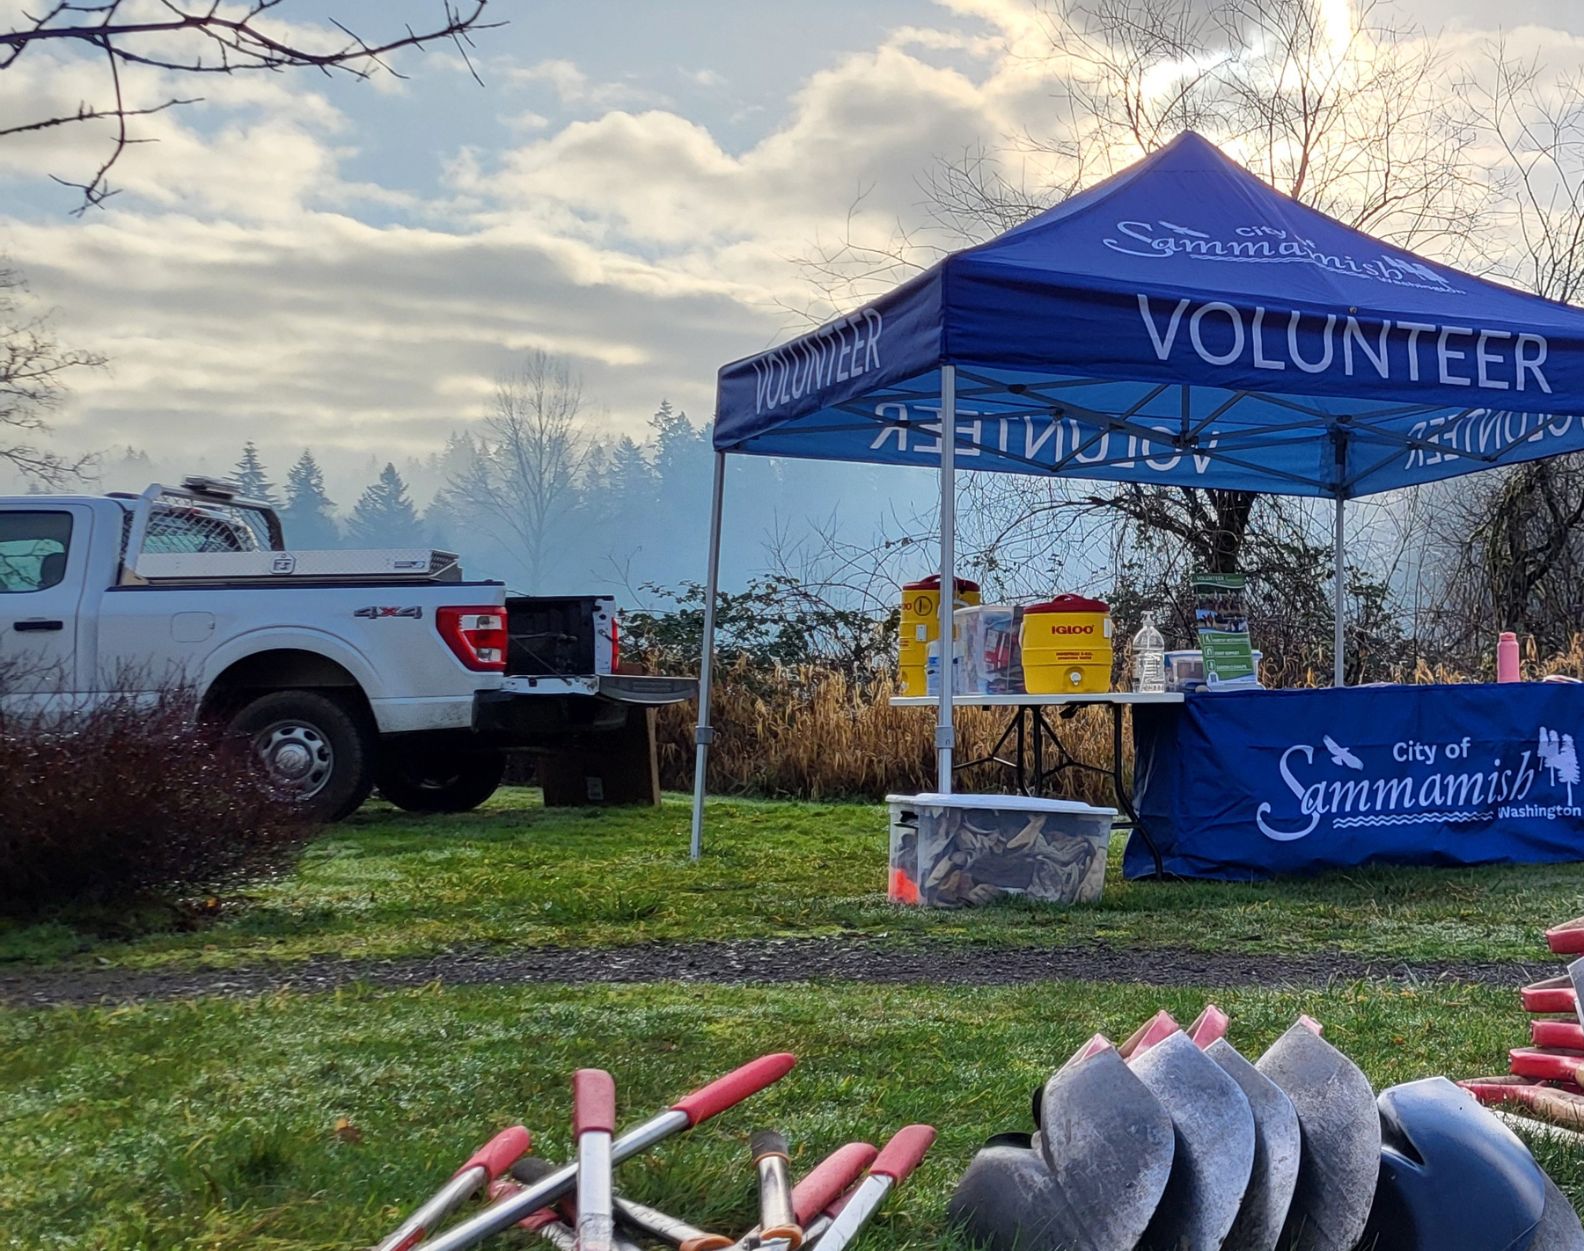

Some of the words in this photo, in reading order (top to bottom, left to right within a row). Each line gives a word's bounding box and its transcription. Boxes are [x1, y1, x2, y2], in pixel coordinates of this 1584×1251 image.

[1103, 221, 1402, 281] Sammamish
[752, 308, 882, 414] VOLUNTEER
[1137, 294, 1553, 394] VOLUNTEER
[1051, 625, 1095, 634] IGLOO
[1393, 741, 1437, 764] City
[1445, 737, 1471, 759] of
[1256, 744, 1535, 841] Sammamish
[1498, 803, 1582, 820] Washington
